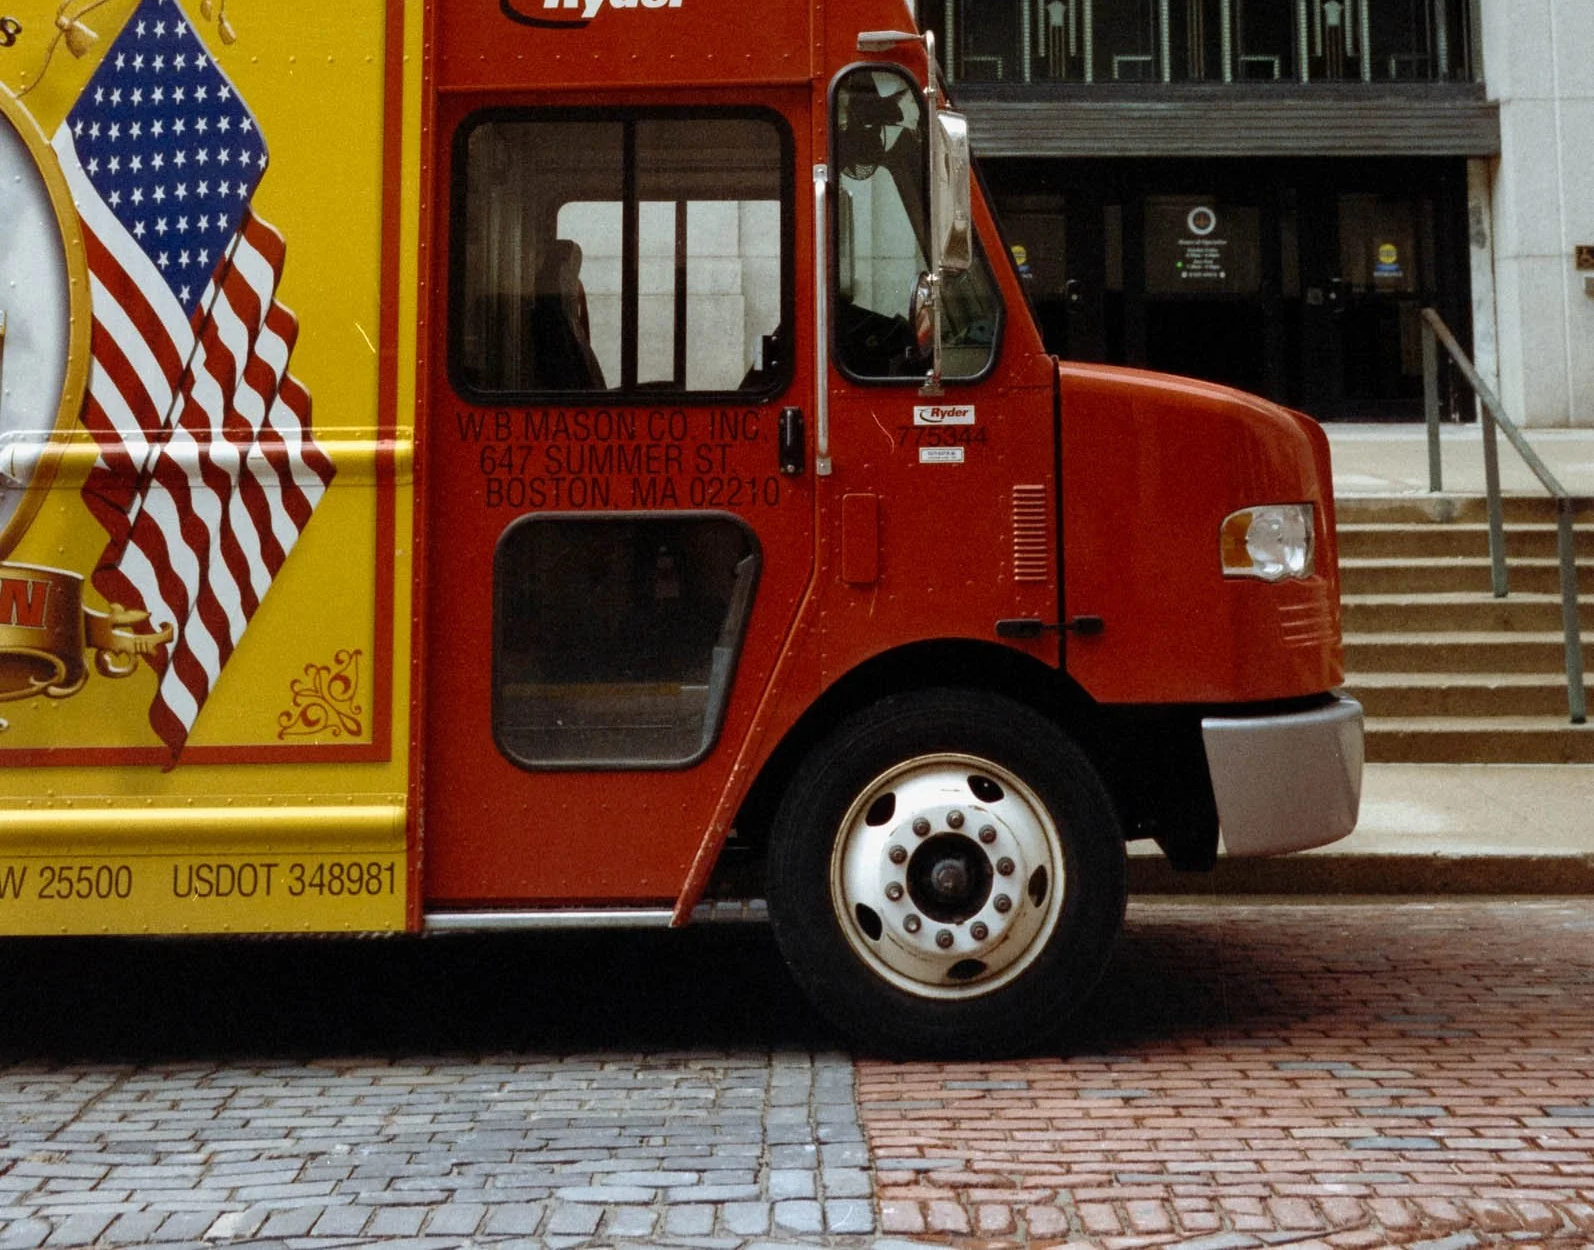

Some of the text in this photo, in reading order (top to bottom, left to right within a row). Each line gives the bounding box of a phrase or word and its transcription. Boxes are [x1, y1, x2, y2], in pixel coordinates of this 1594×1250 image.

[647, 410, 697, 442] CO.
[710, 410, 768, 441] INC.
[930, 407, 969, 419] Ryder
[897, 425, 987, 447] 775344
[479, 445, 533, 476] 647
[544, 444, 683, 475] SUMMER
[486, 476, 780, 510] BOSTON, MA 02210
[38, 864, 133, 900] 25500
[172, 861, 396, 898] USDOT 348981
